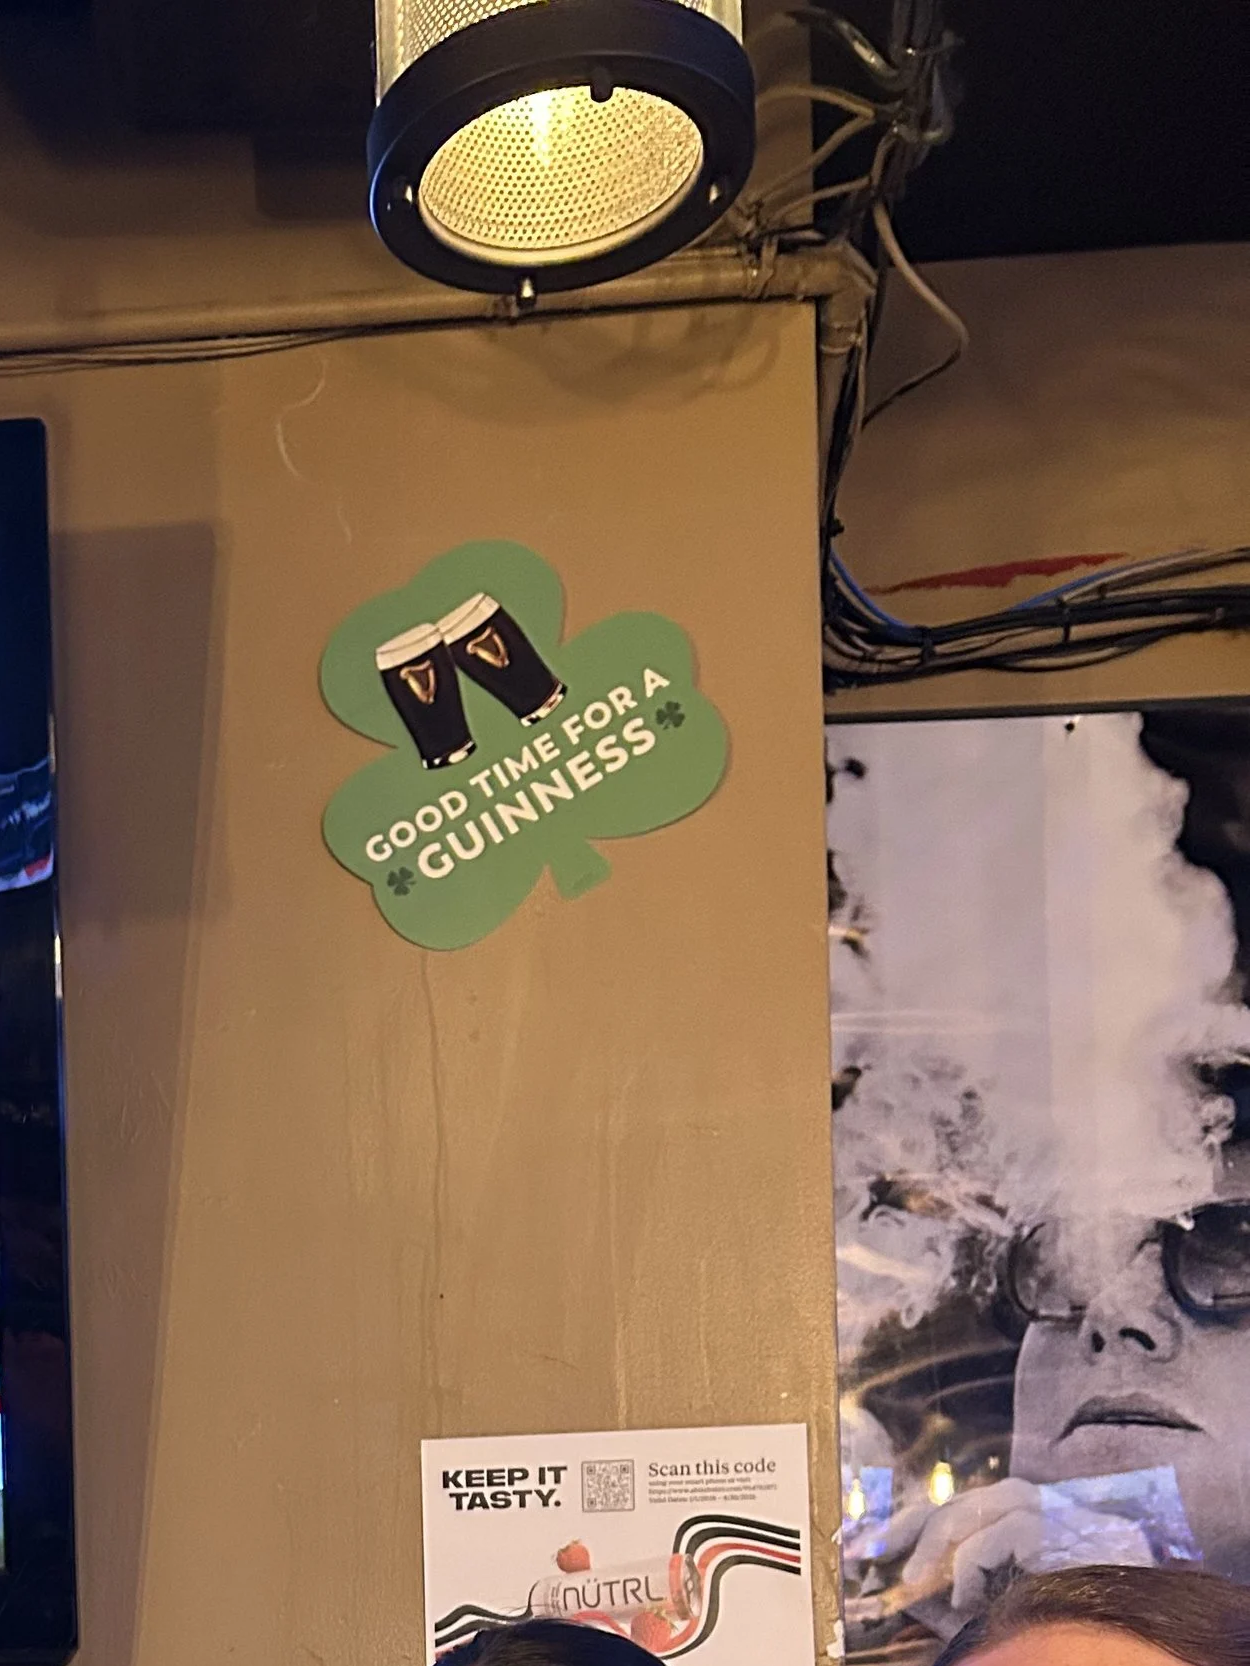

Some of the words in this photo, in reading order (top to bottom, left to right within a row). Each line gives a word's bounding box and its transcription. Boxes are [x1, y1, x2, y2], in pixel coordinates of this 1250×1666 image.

[365, 789, 468, 862] GOOD
[469, 732, 561, 798] TIME
[561, 686, 638, 745] FOR
[642, 668, 670, 699] A
[417, 717, 656, 879] GUINNESS
[442, 1467, 529, 1489] KEEP
[538, 1465, 568, 1485] IT
[648, 1462, 691, 1477] Scan
[696, 1459, 730, 1475] this
[733, 1457, 777, 1474] code
[448, 1488, 562, 1511] TASTY.
